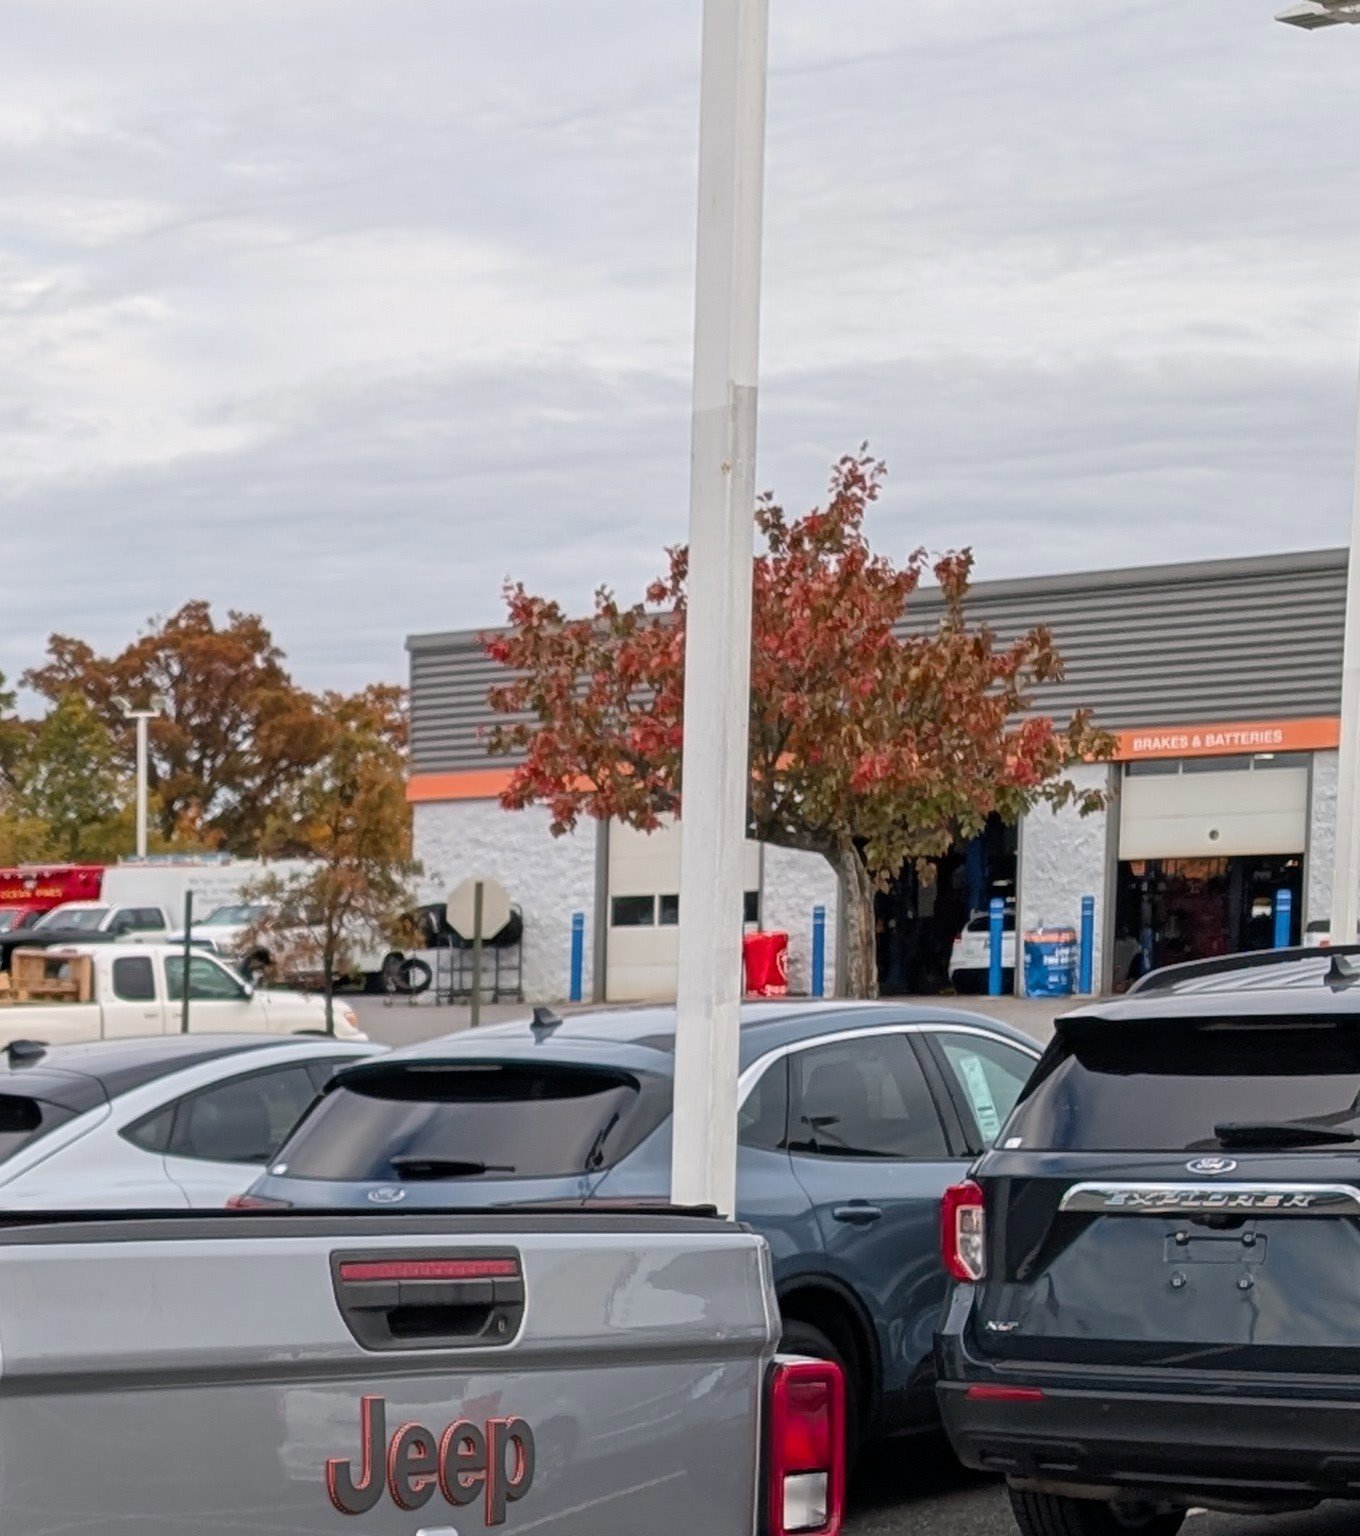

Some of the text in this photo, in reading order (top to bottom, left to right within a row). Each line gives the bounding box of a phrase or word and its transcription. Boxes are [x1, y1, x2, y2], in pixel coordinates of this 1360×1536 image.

[1133, 729, 1283, 751] BRAKES & BATTERIES
[1103, 1189, 1317, 1208] EXPLORER
[326, 1395, 536, 1527] Jeep
